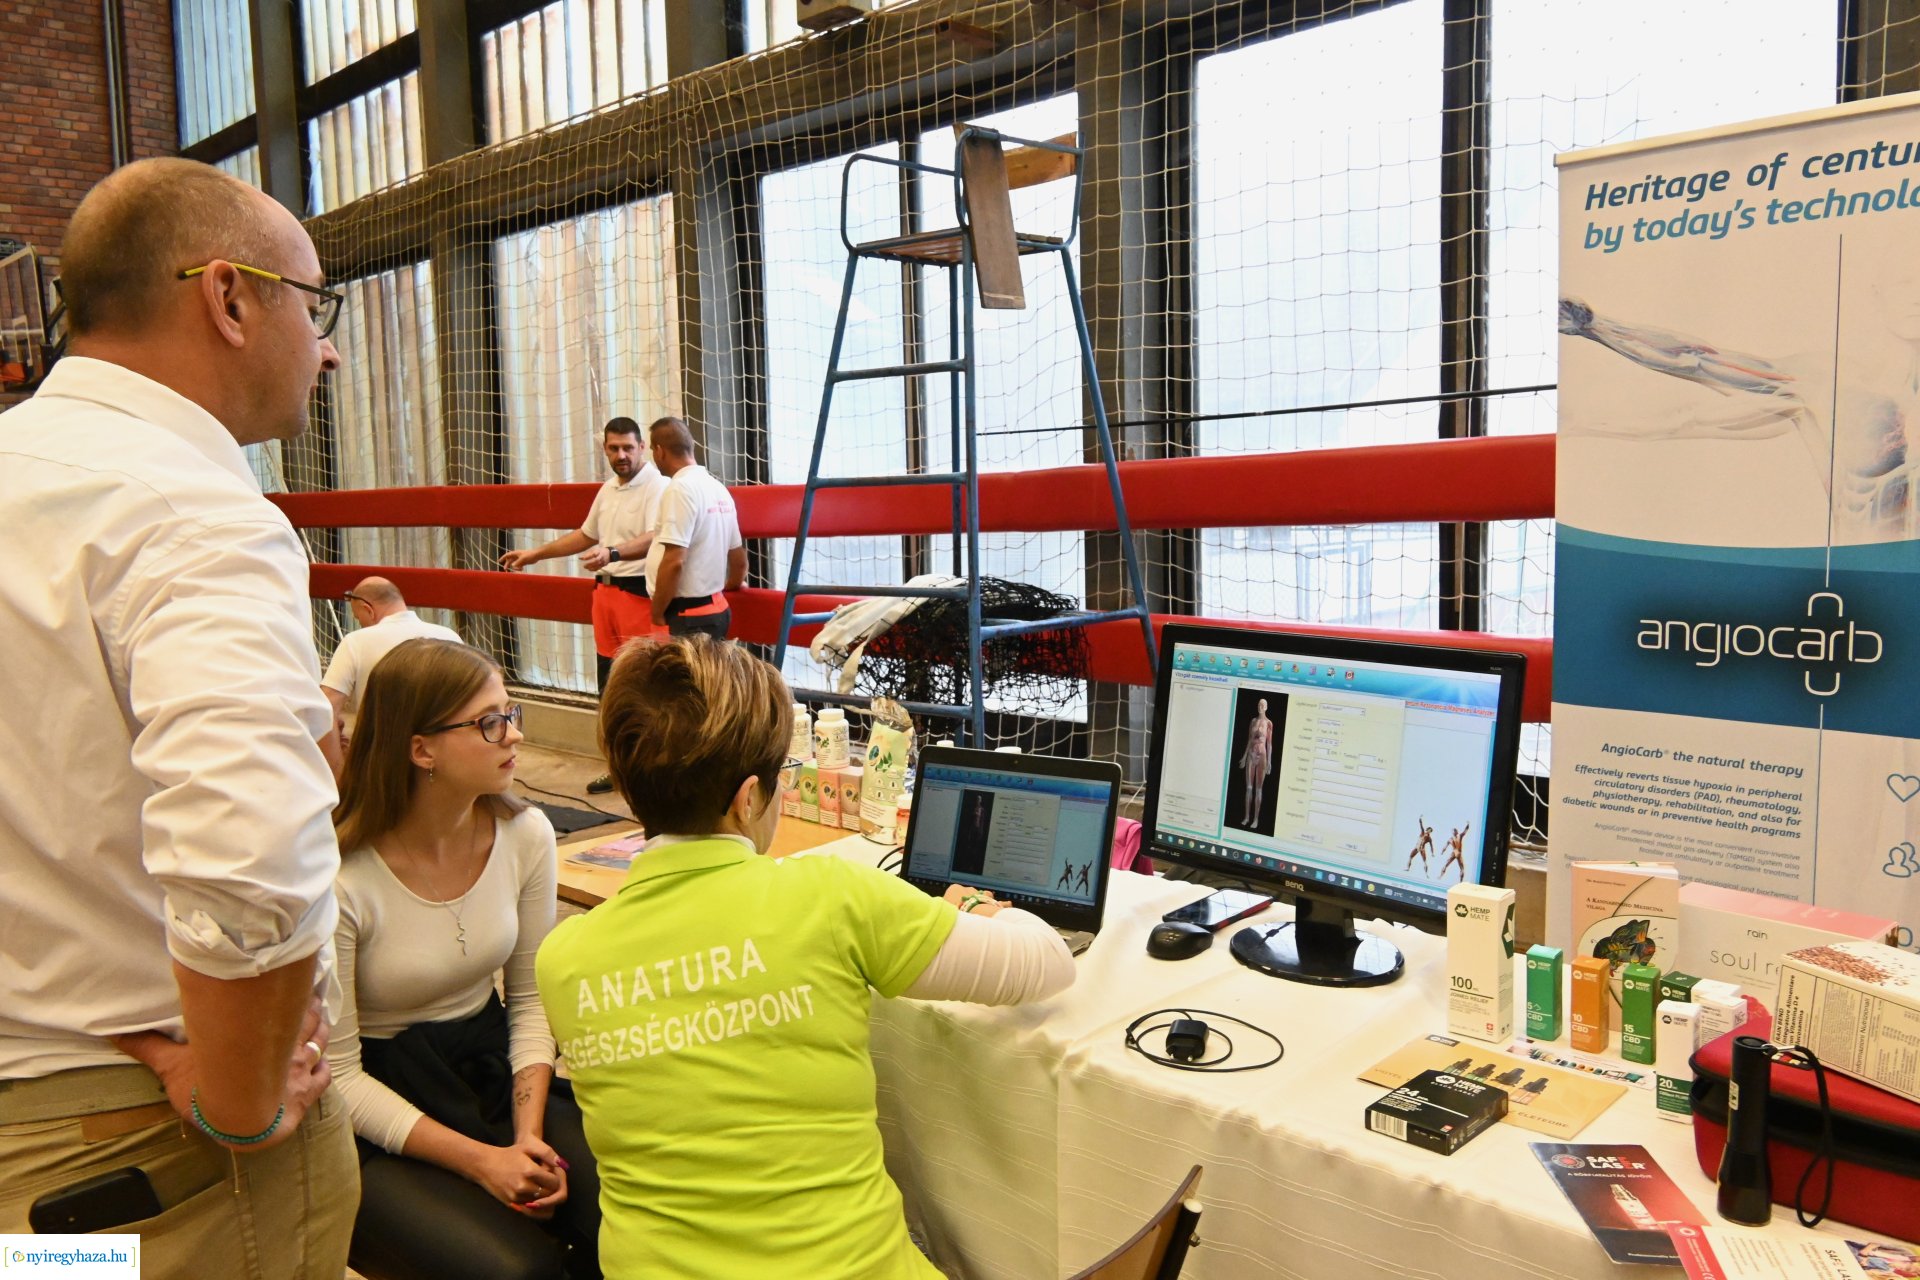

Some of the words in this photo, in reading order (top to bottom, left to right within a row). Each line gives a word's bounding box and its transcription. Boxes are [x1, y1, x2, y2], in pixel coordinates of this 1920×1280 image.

[1585, 169, 1730, 210] Heritage
[1746, 152, 1788, 190] of
[1584, 222, 1624, 253] by
[1633, 198, 1756, 242] today's
[1637, 620, 1883, 667] angiocarb
[1673, 751, 1694, 763] the
[1697, 755, 1744, 769] natural
[1750, 760, 1803, 778] therapy
[1574, 764, 1623, 779] Effectively
[1626, 771, 1659, 782] reverts
[1662, 775, 1691, 786] tissue
[1693, 778, 1732, 792] hypoxia
[1735, 785, 1745, 794] in
[1748, 786, 1803, 802] peripheral
[1594, 778, 1645, 793] circulatory
[1647, 785, 1690, 799] disorders
[1693, 791, 1721, 804] (PAD),
[1725, 795, 1802, 815] rheumatology,
[1592, 790, 1662, 808] physiotherapy,
[1666, 800, 1734, 818] rehabilitation,
[1737, 809, 1758, 820] and
[1760, 812, 1783, 824] also
[1786, 815, 1802, 827] for
[1562, 796, 1597, 809] diabetic
[1599, 801, 1635, 814] wounds
[1637, 807, 1647, 815] or
[1650, 808, 1660, 817] in
[1662, 811, 1713, 826] preventive
[1715, 817, 1749, 831] health
[1751, 823, 1801, 839] programs
[1654, 832, 1675, 840] device
[1470, 906, 1491, 915] HEMP
[1470, 913, 1490, 921] MATE
[1747, 929, 1768, 940] rain
[1710, 949, 1757, 972] soul
[577, 938, 767, 1018] ANATURA
[1451, 975, 1472, 990] 100
[1785, 974, 1795, 1009] Alimentare
[1527, 1013, 1543, 1022] CBD
[1572, 1013, 1582, 1022] 10
[1790, 1007, 1798, 1034] Vitamina
[1860, 997, 1870, 1034] Nutrizionali
[1572, 1024, 1589, 1034] CBD
[1623, 1023, 1634, 1033] 15
[1623, 1034, 1641, 1045] CBD
[1454, 1083, 1482, 1094] MATE
[1458, 1079, 1486, 1091] HEMP
[1659, 1077, 1673, 1089] 20
[1396, 1087, 1420, 1098] 24
[1825, 1249, 1844, 1267] SAFE
